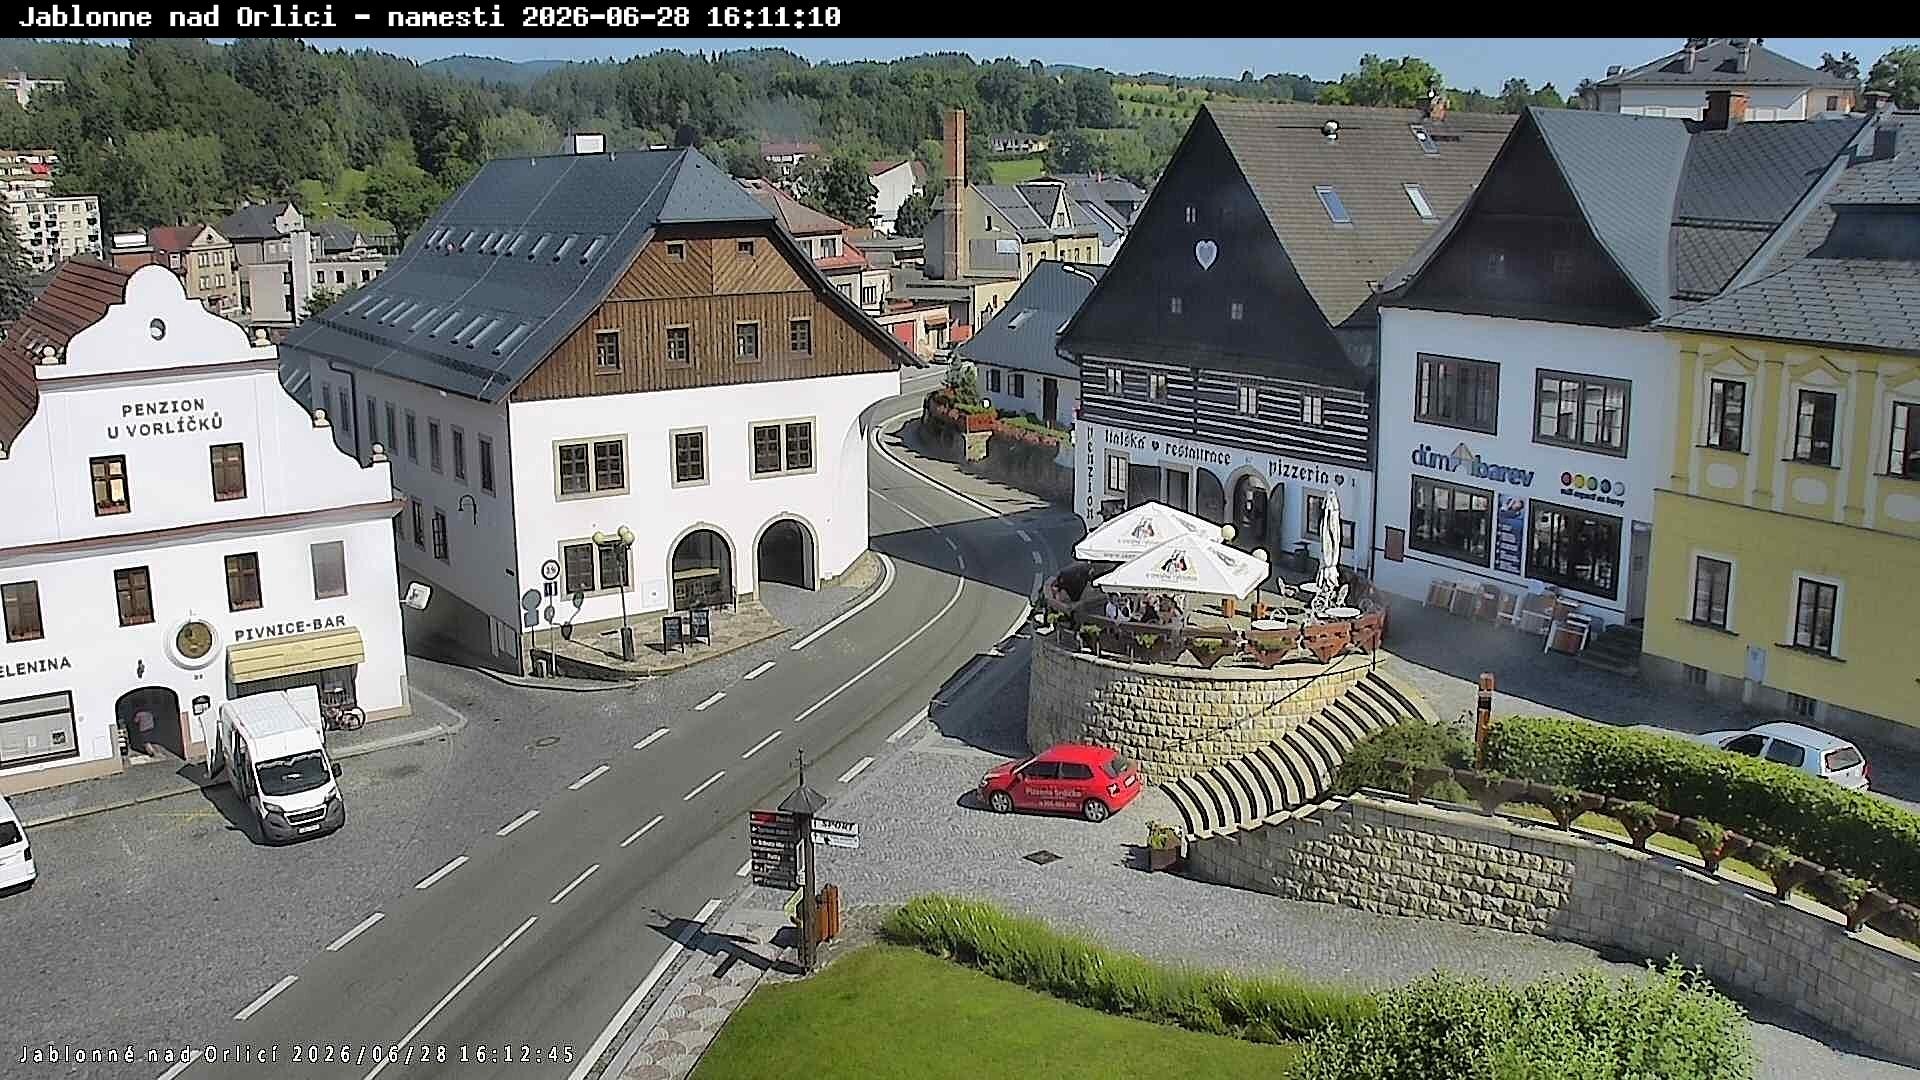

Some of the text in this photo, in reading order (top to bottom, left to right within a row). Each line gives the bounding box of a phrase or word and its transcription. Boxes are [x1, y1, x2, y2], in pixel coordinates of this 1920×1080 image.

[121, 398, 205, 418] PENZION
[107, 411, 223, 439] U VORLÍČKŮ
[234, 615, 346, 641] PIVNICE-BAR
